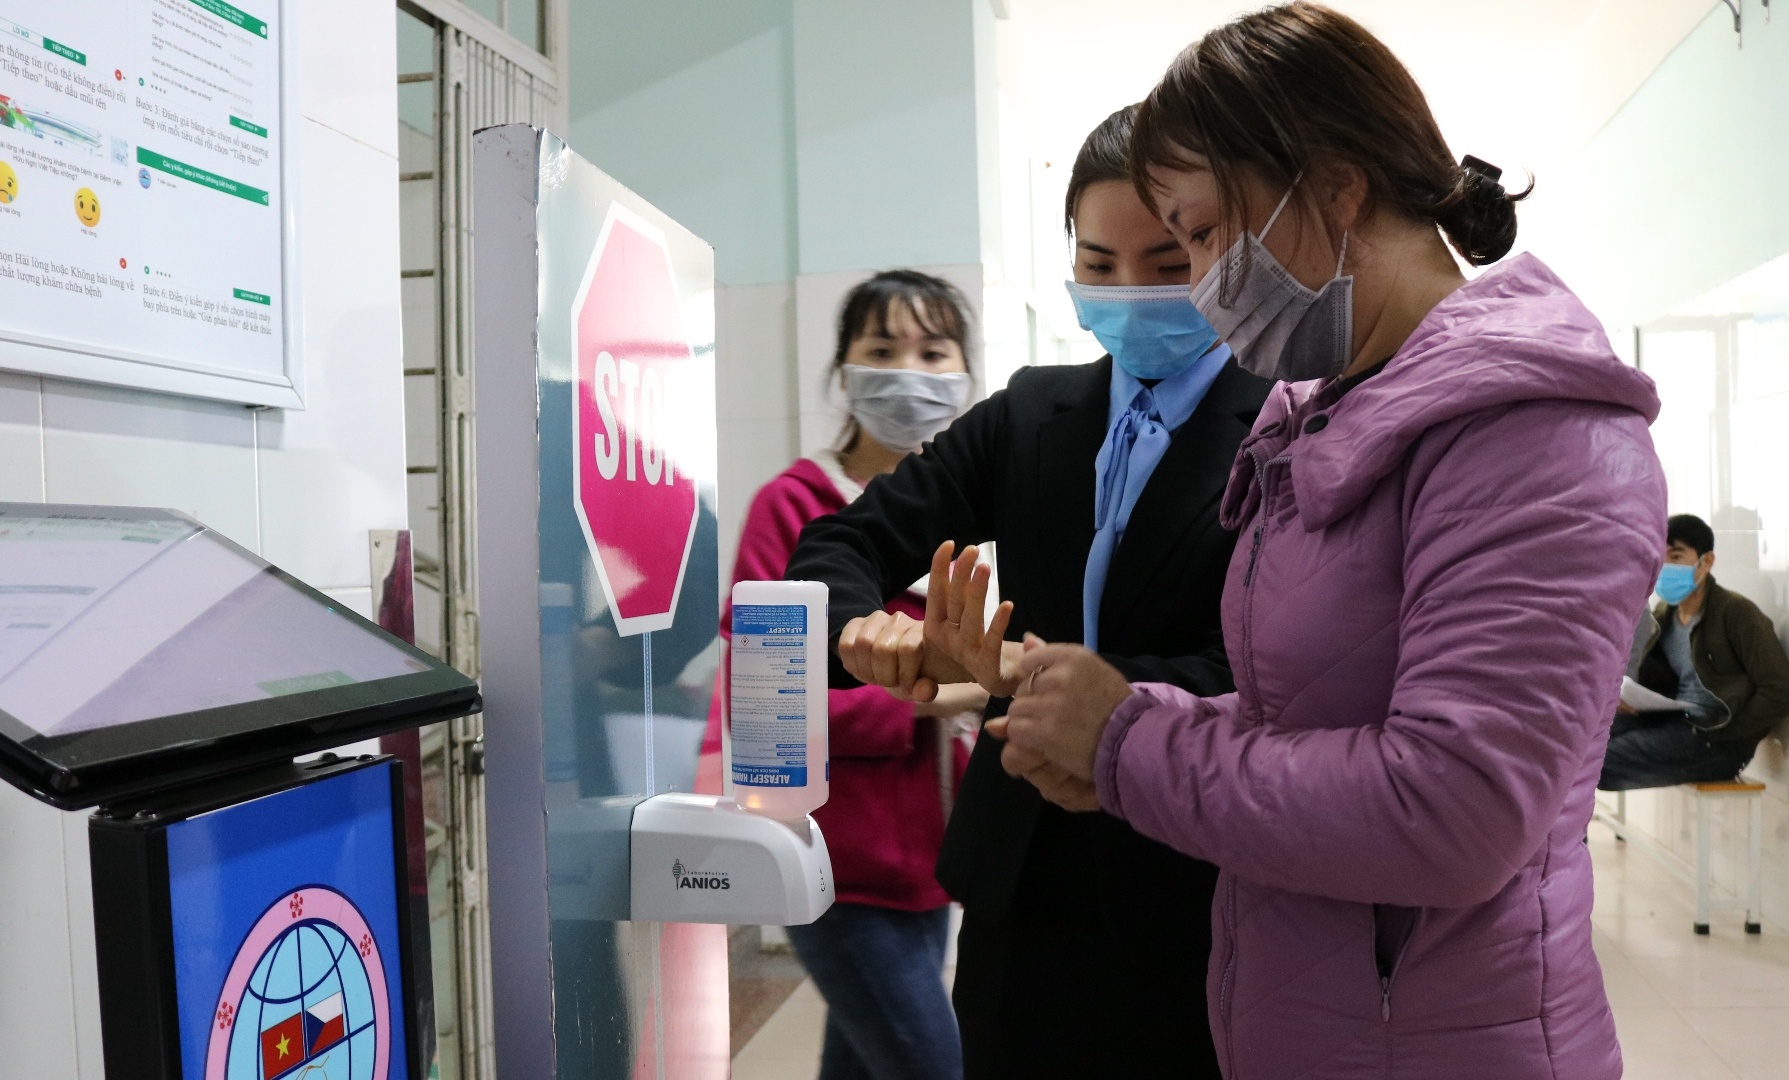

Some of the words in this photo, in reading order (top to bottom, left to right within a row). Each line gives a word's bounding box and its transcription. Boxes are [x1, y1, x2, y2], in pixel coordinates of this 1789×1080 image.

[6, 44, 30, 64] thông
[32, 56, 42, 68] tin
[44, 60, 58, 75] (Có
[74, 72, 96, 94] không
[45, 76, 62, 93] hoặc
[65, 84, 78, 99] dấu
[136, 97, 153, 114] Bước
[162, 108, 178, 122] Đánh
[180, 116, 190, 128] giá
[206, 126, 216, 138] các
[218, 130, 232, 144] chọn
[241, 140, 250, 150] sao
[157, 121, 166, 132] với
[214, 143, 228, 157] chọn
[15, 252, 30, 266] Hài
[32, 256, 48, 273] lòng
[51, 261, 68, 278] hoặc
[71, 266, 96, 284] Không
[97, 271, 108, 284] hài
[110, 275, 124, 291] lòng
[17, 269, 40, 287] lượng
[42, 274, 63, 289] khám
[65, 279, 83, 294] chữa
[84, 284, 102, 298] bệnh
[750, 774, 790, 784] ALFASEPT
[680, 876, 730, 890] ANIOS
